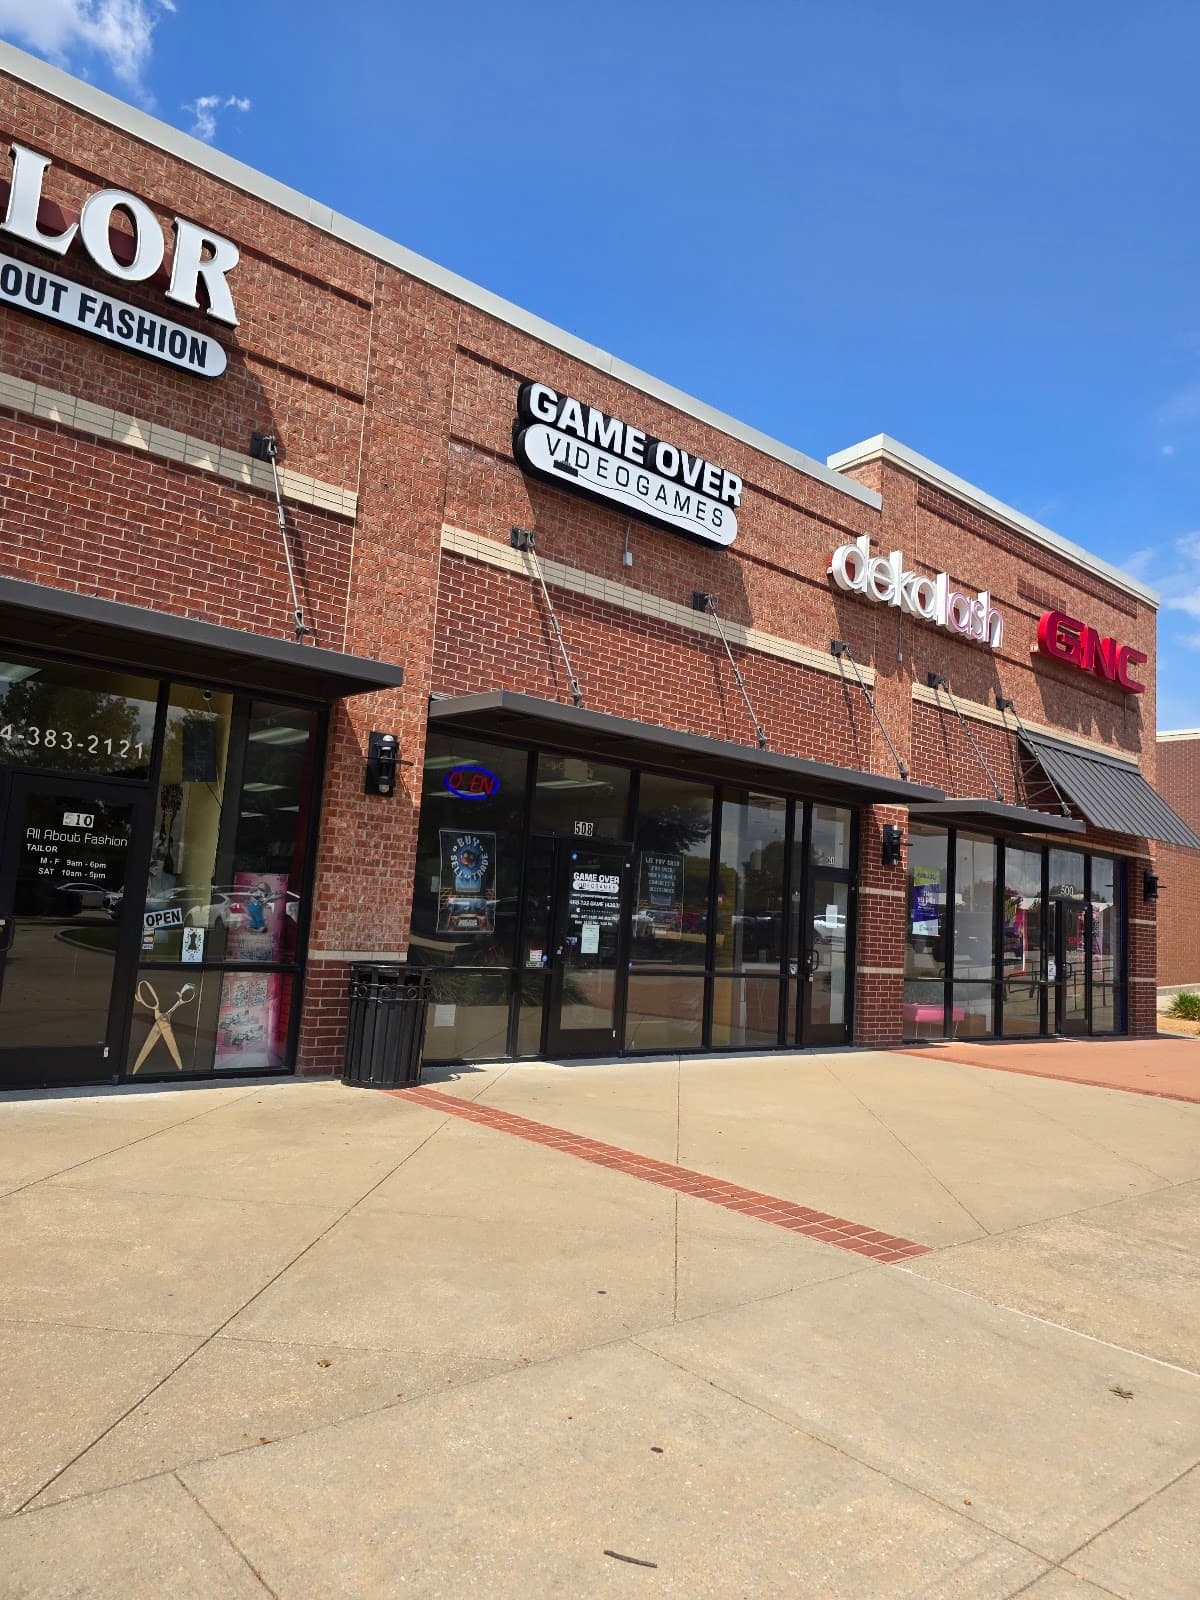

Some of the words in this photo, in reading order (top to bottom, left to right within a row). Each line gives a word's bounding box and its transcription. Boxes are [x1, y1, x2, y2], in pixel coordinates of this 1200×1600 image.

[0, 142, 240, 327] LOR
[0, 263, 68, 313] OUT
[77, 292, 208, 368] FASHION
[529, 382, 646, 465] GAME
[655, 441, 743, 507] OVER
[546, 432, 723, 528] VIDEOGAMES
[1037, 610, 1147, 694] GNC
[0, 724, 143, 759] 4-383-2121
[449, 771, 494, 795] OEN
[63, 812, 94, 828] 510
[575, 822, 593, 836] 508
[26, 828, 41, 840] All
[43, 829, 81, 843] About
[84, 832, 128, 847] Fashion
[457, 835, 480, 847] BUY
[26, 843, 58, 853] TAILOR
[38, 867, 54, 875] SAT
[61, 869, 82, 877] 10am
[66, 859, 83, 867] 9am
[573, 872, 597, 882] GAME
[599, 875, 619, 885] OVER
[146, 910, 180, 927] OPEN
